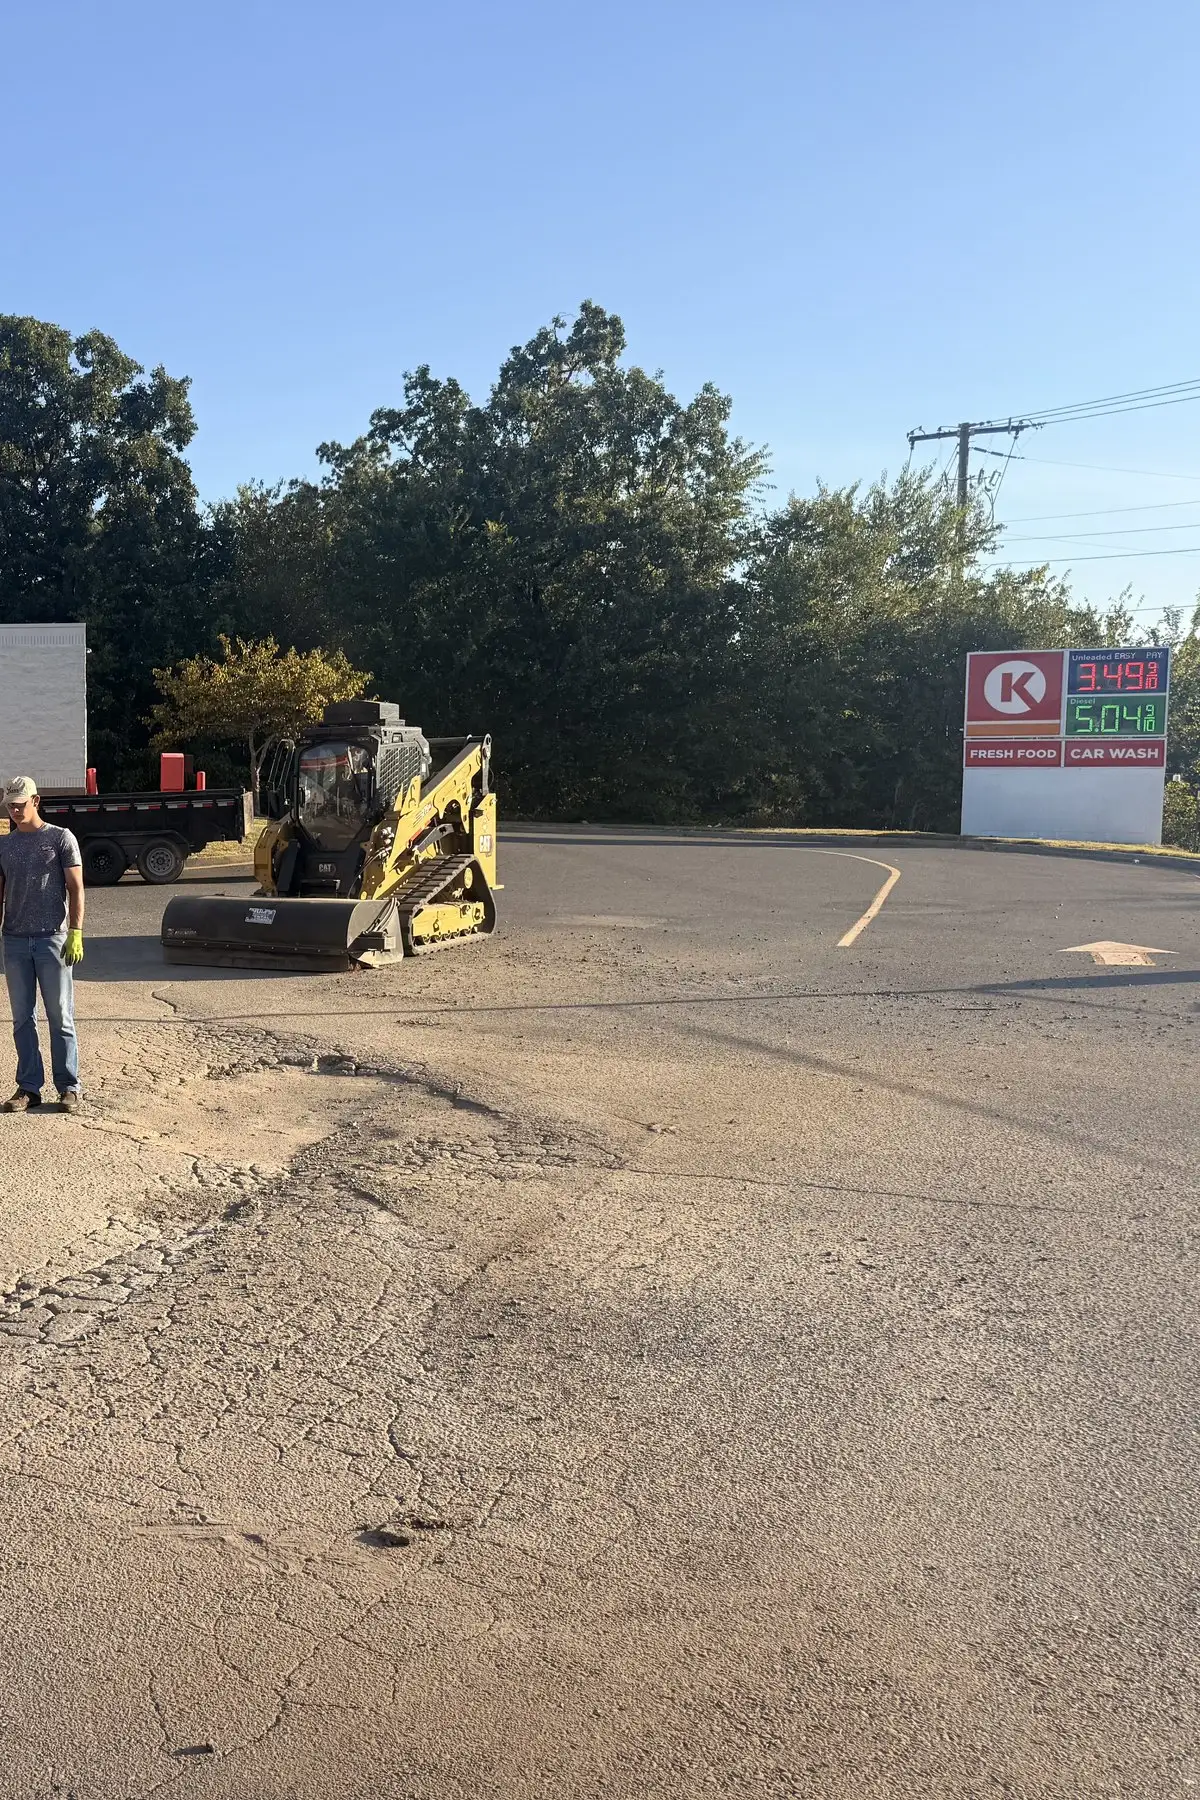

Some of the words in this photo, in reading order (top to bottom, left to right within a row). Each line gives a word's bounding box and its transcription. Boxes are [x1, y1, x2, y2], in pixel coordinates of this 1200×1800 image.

[1072, 653, 1112, 661] Unleaded
[1114, 652, 1136, 660] EASY
[1146, 651, 1163, 659] PAY
[1078, 662, 1144, 691] 3.49
[1075, 705, 1141, 733] 5.04
[970, 749, 1013, 759] FRESH
[1017, 749, 1056, 759] FOOD
[1070, 748, 1104, 759] CAR
[1109, 748, 1159, 759] WASH
[318, 863, 332, 873] CAT
